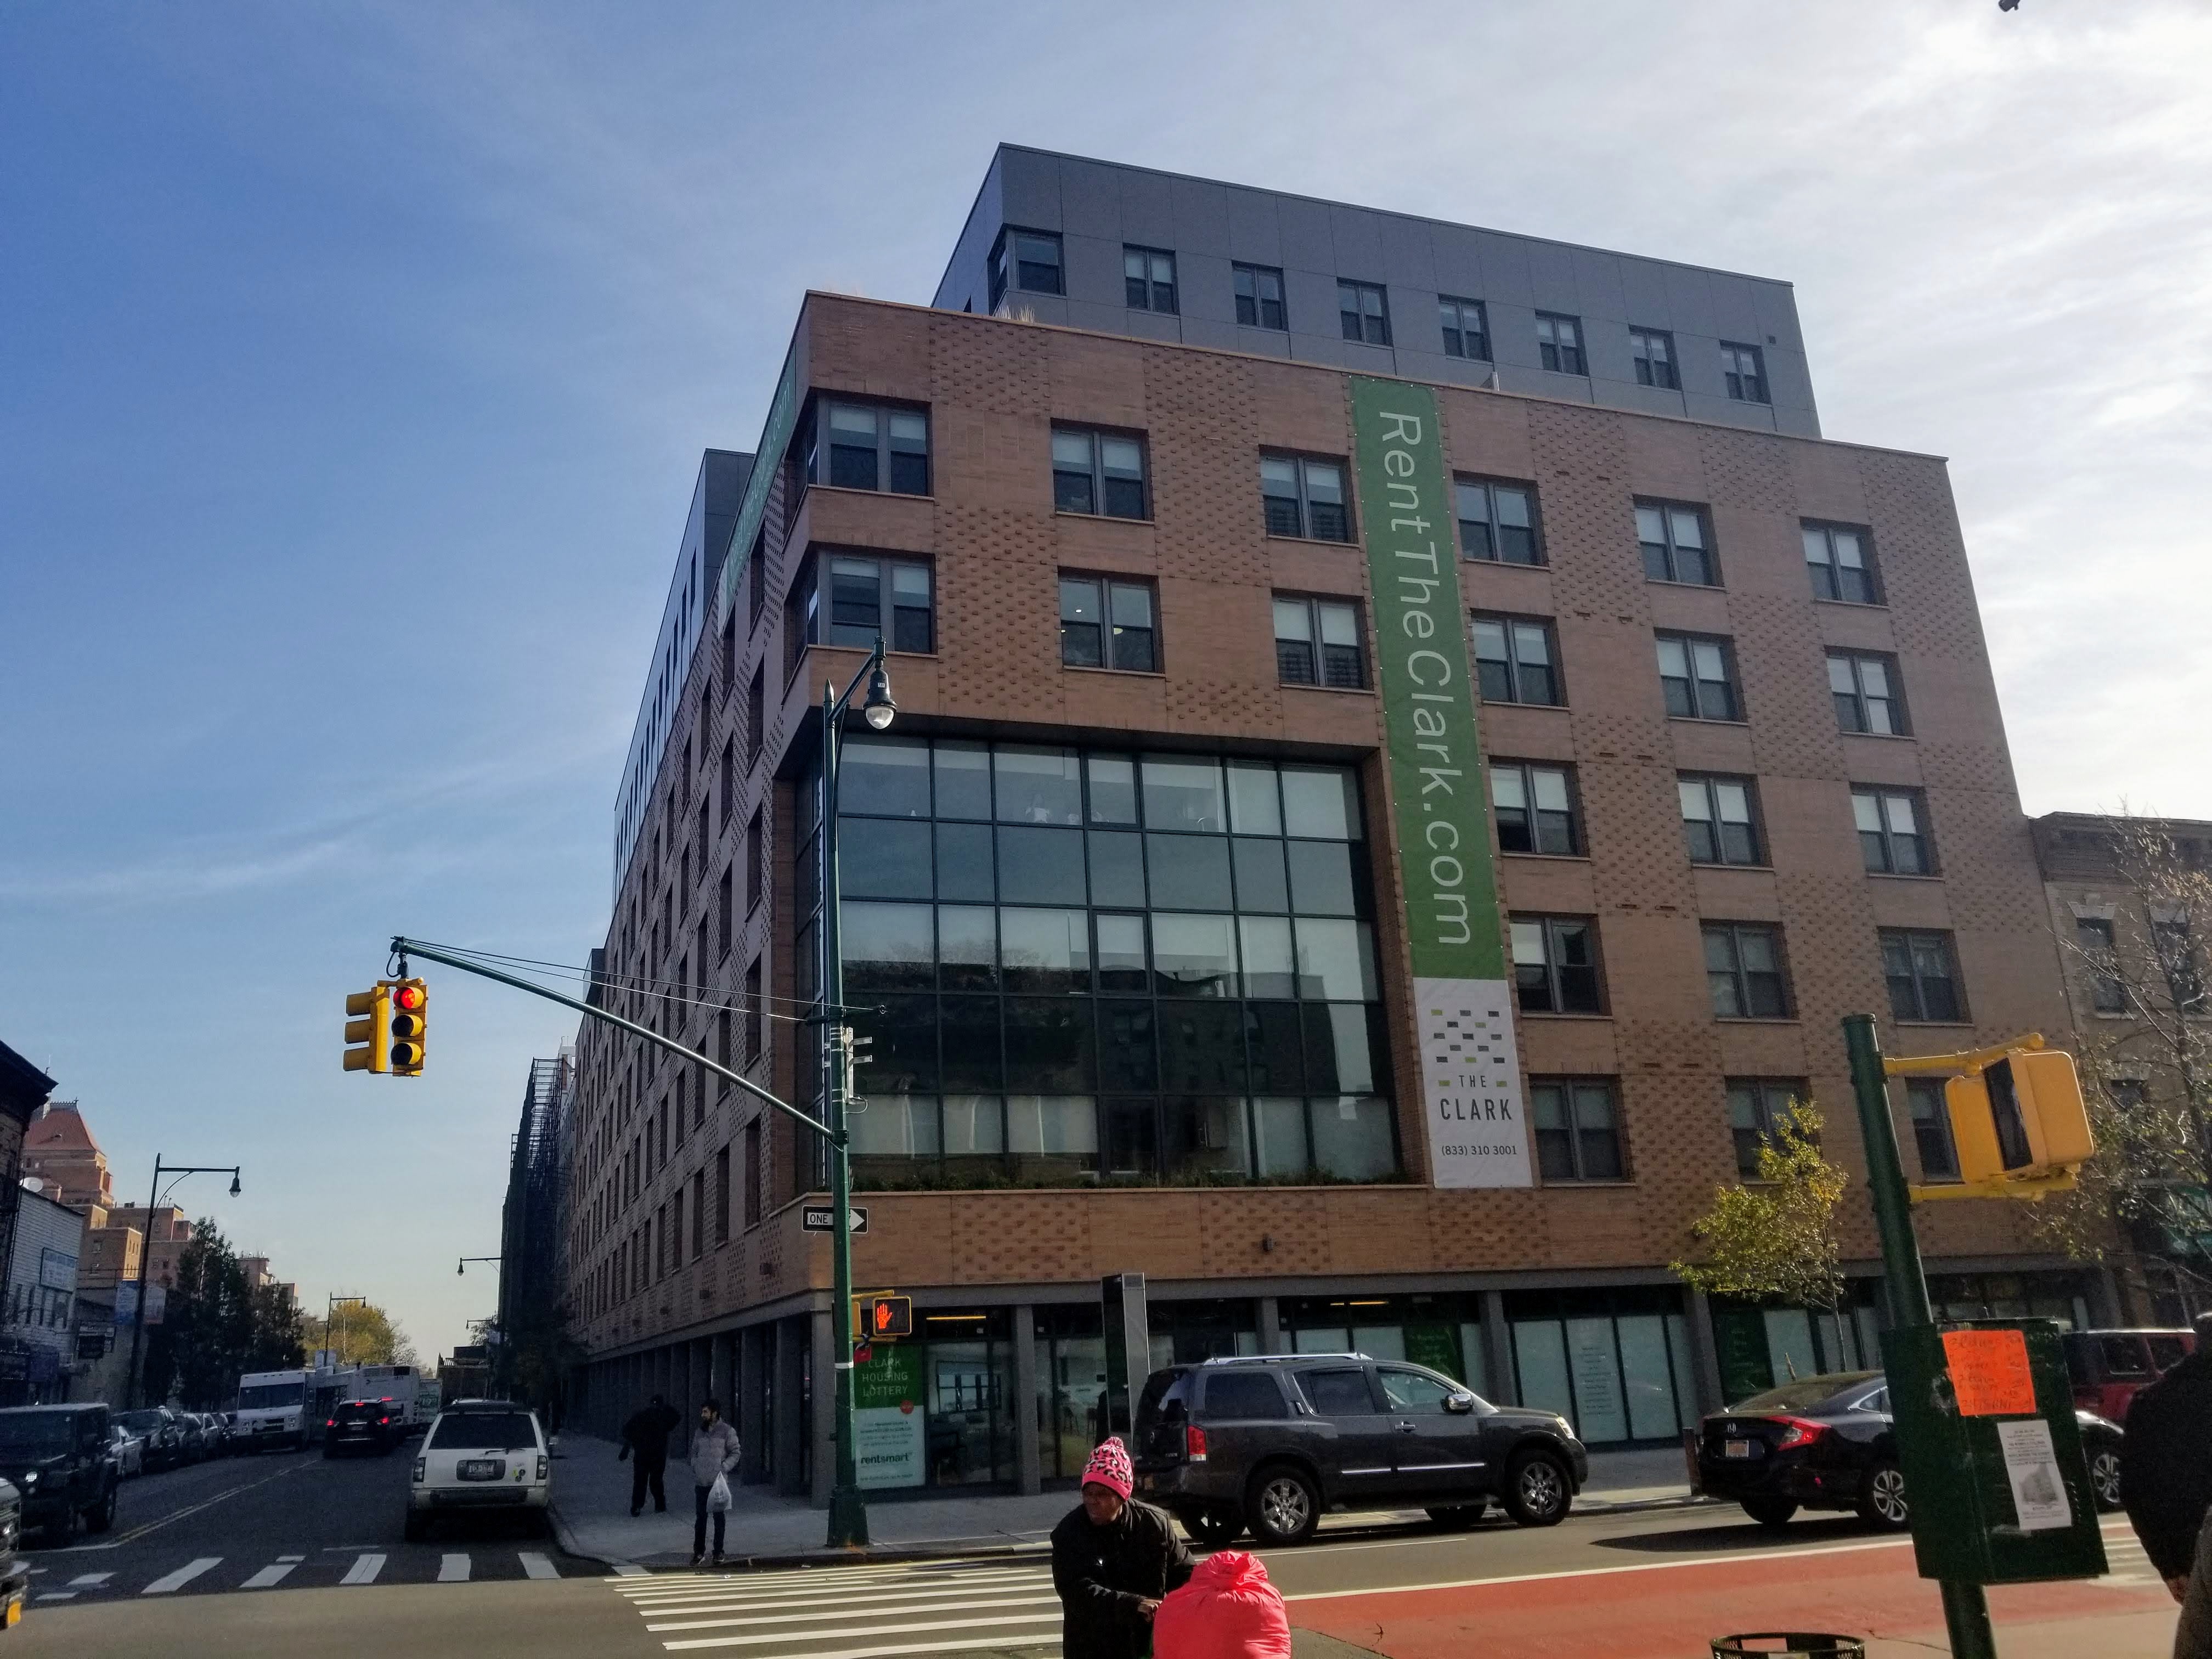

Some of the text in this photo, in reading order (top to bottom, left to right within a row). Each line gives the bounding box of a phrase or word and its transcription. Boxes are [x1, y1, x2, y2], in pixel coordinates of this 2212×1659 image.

[1379, 411, 1471, 946] RentTheClark.com
[1458, 1075, 1487, 1088] THE
[1440, 1098, 1512, 1121] CLARK
[1441, 1145, 1517, 1156] (833) 310 3001
[810, 1214, 828, 1224] ONE
[868, 1358, 901, 1368] CLARK
[862, 1372, 909, 1383] HOUSING
[862, 1385, 908, 1397] LOTTERY
[861, 1453, 909, 1464] rentsmart
